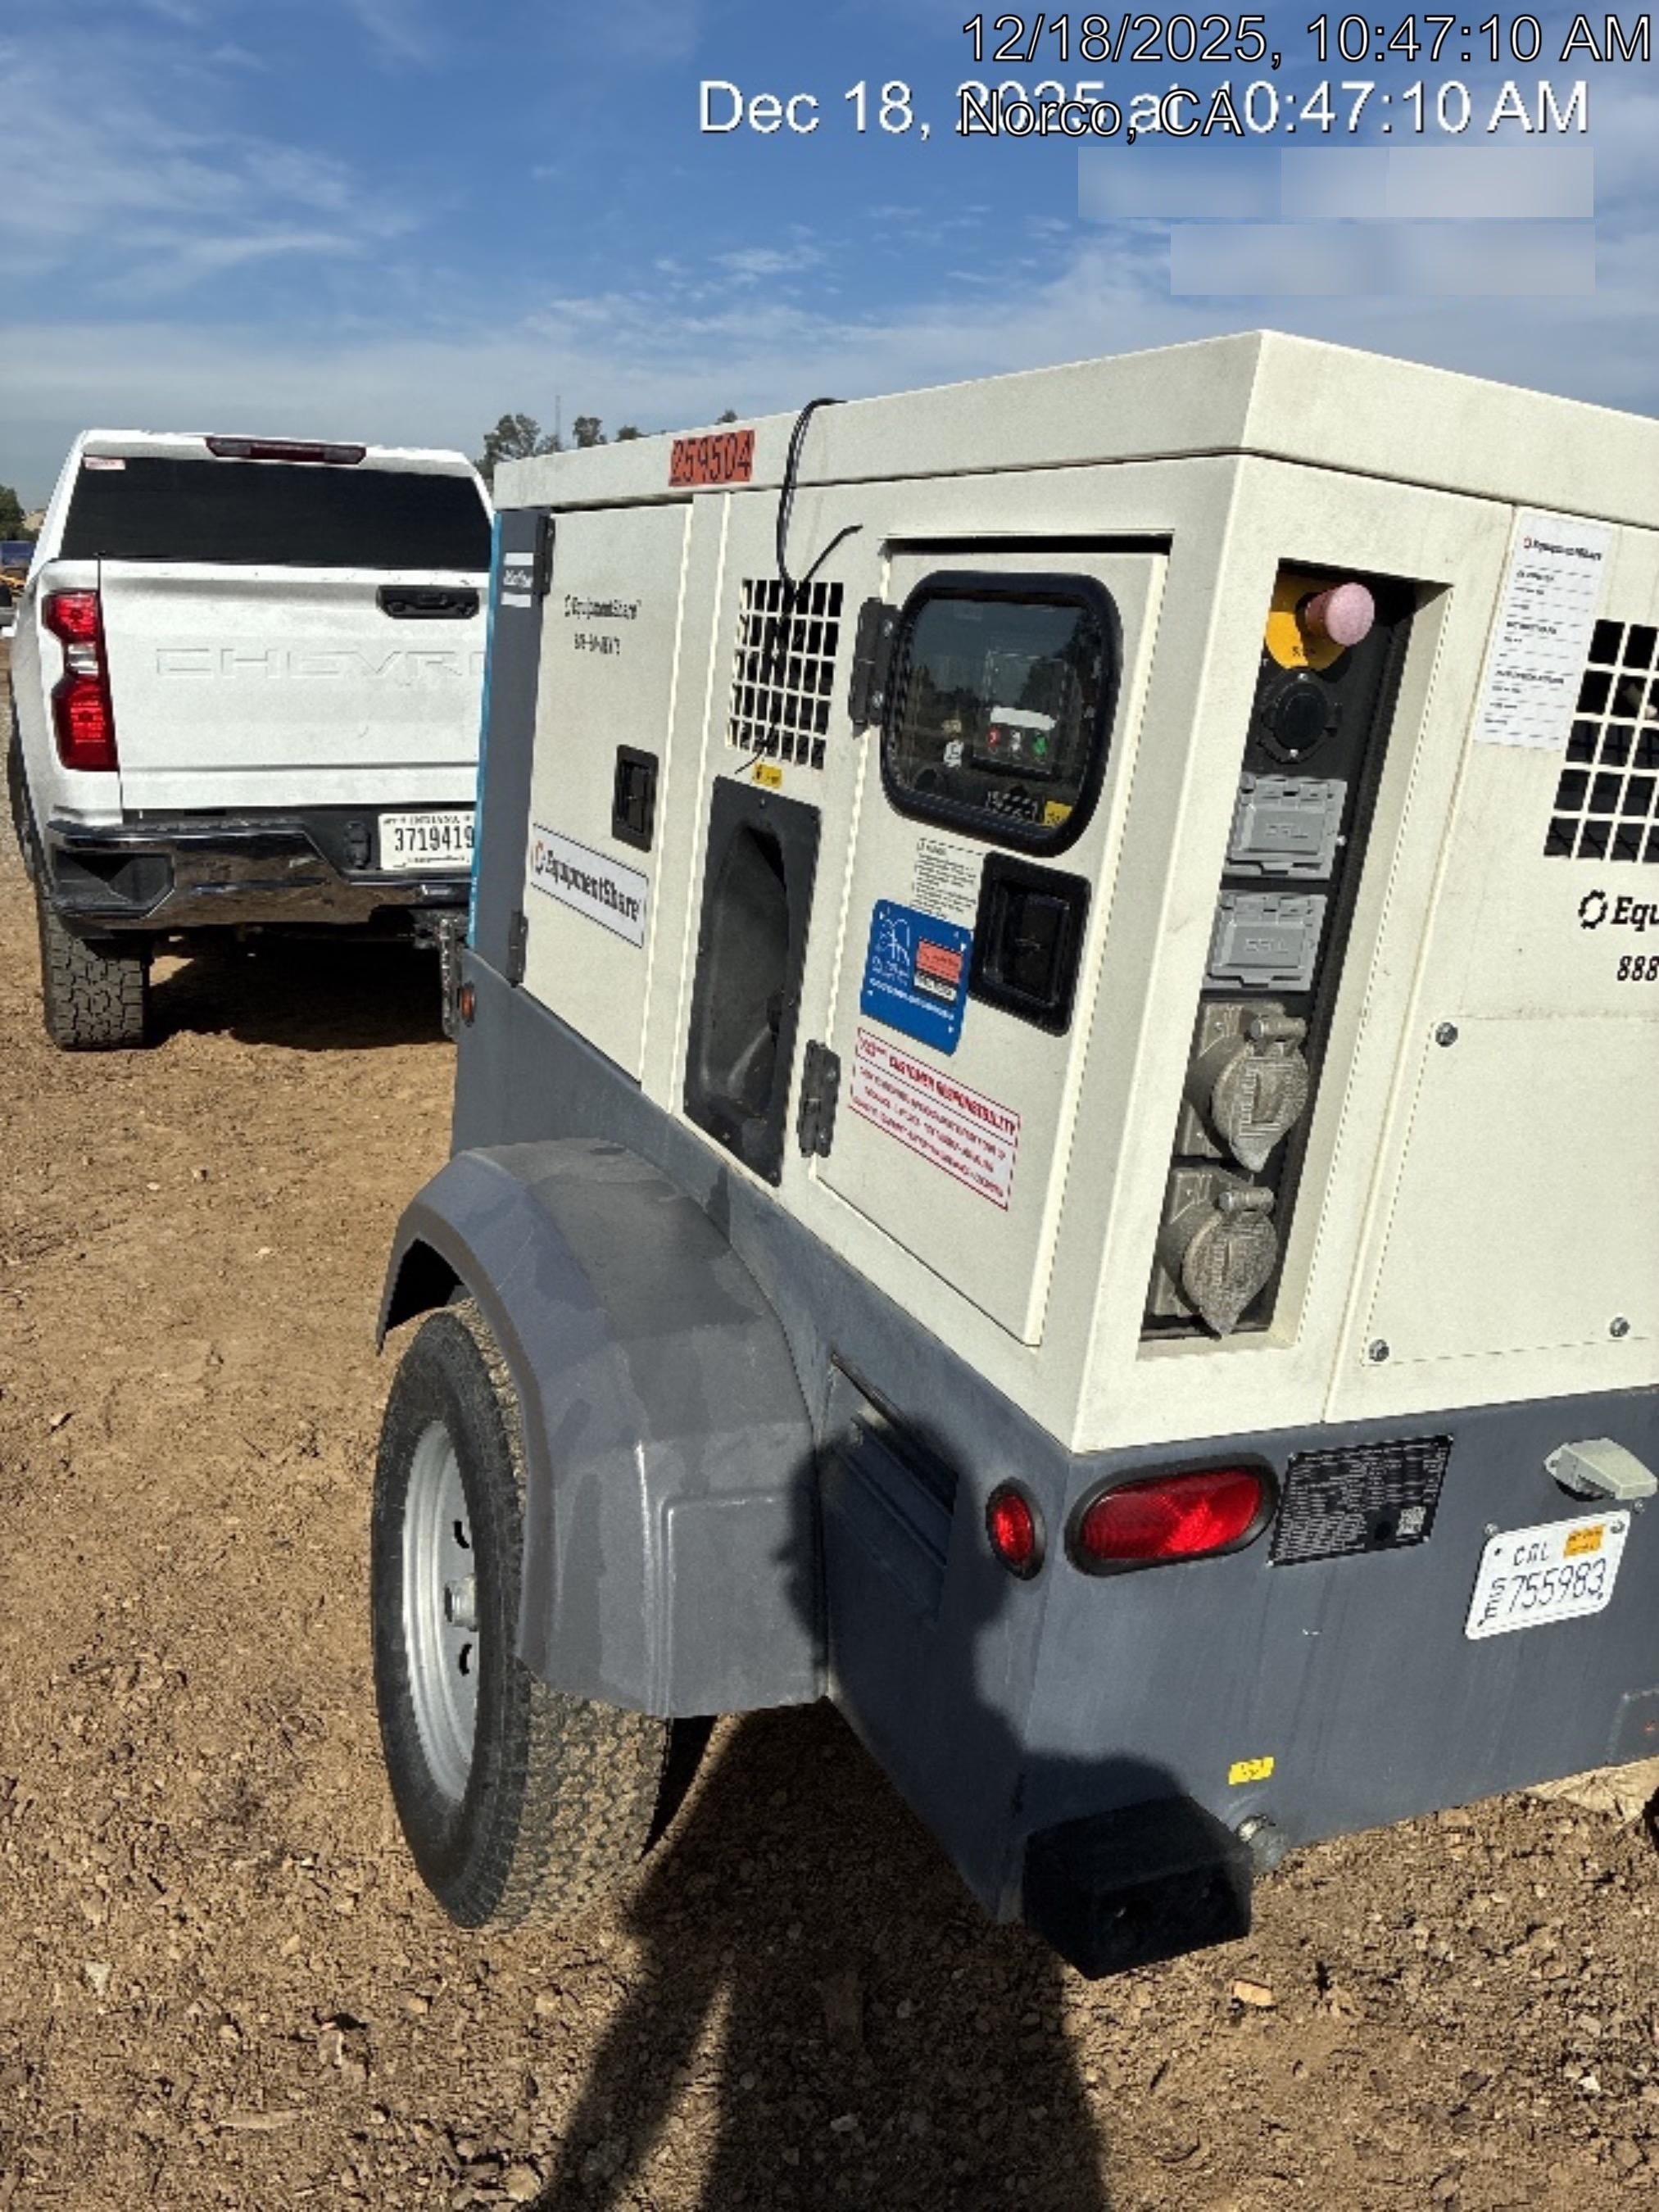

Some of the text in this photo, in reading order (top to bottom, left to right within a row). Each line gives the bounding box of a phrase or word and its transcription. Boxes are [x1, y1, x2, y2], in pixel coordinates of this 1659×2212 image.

[395, 826, 474, 850] 3719419
[1514, 1540, 1550, 1566] CAL
[1509, 1557, 1607, 1614] 755983
